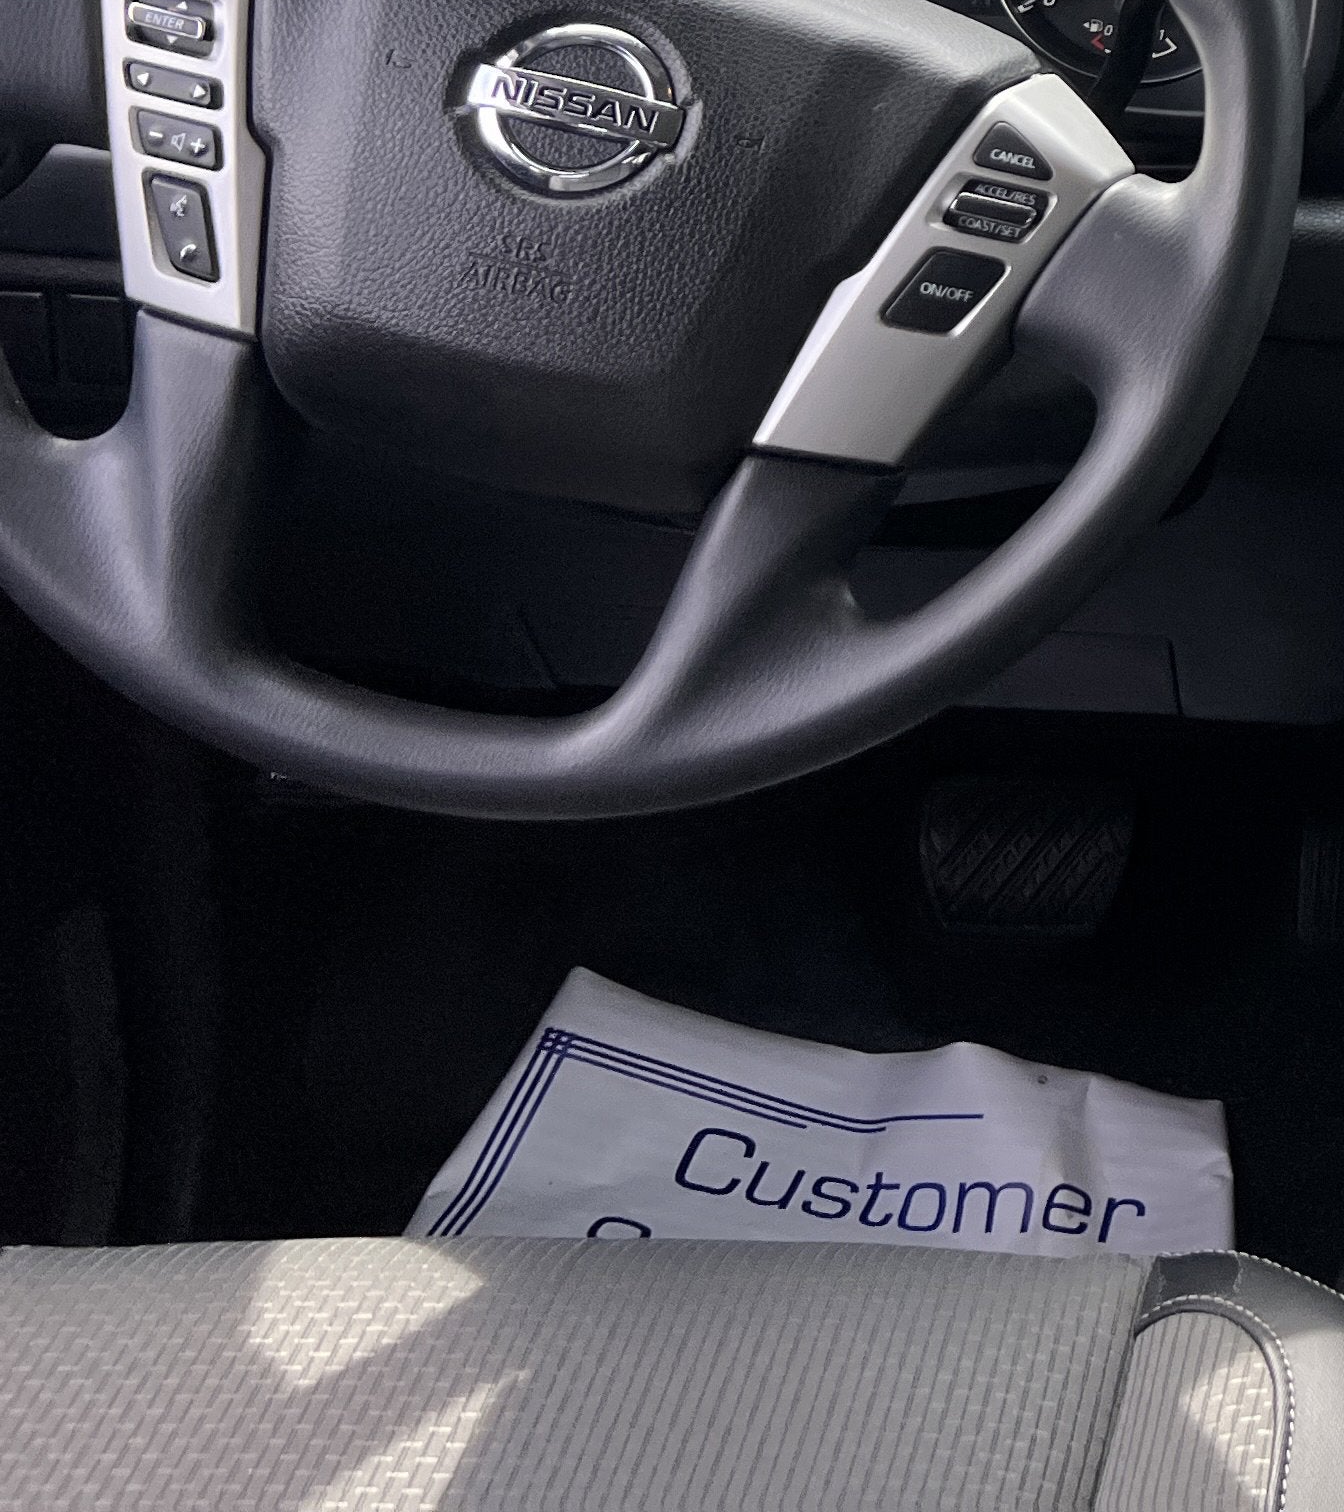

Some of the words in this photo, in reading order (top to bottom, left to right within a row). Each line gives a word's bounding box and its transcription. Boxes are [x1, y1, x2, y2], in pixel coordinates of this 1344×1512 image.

[145, 12, 184, 30] ENTER
[1104, 25, 1113, 36] 0
[491, 75, 660, 135] NISSAN
[990, 148, 1036, 169] CANCEL
[974, 183, 1036, 206] ACCEL/RES
[958, 216, 1021, 238] COAST/SET
[501, 234, 552, 263] SRS
[920, 281, 974, 302] ON/OFF
[674, 1127, 1146, 1243] Customer
